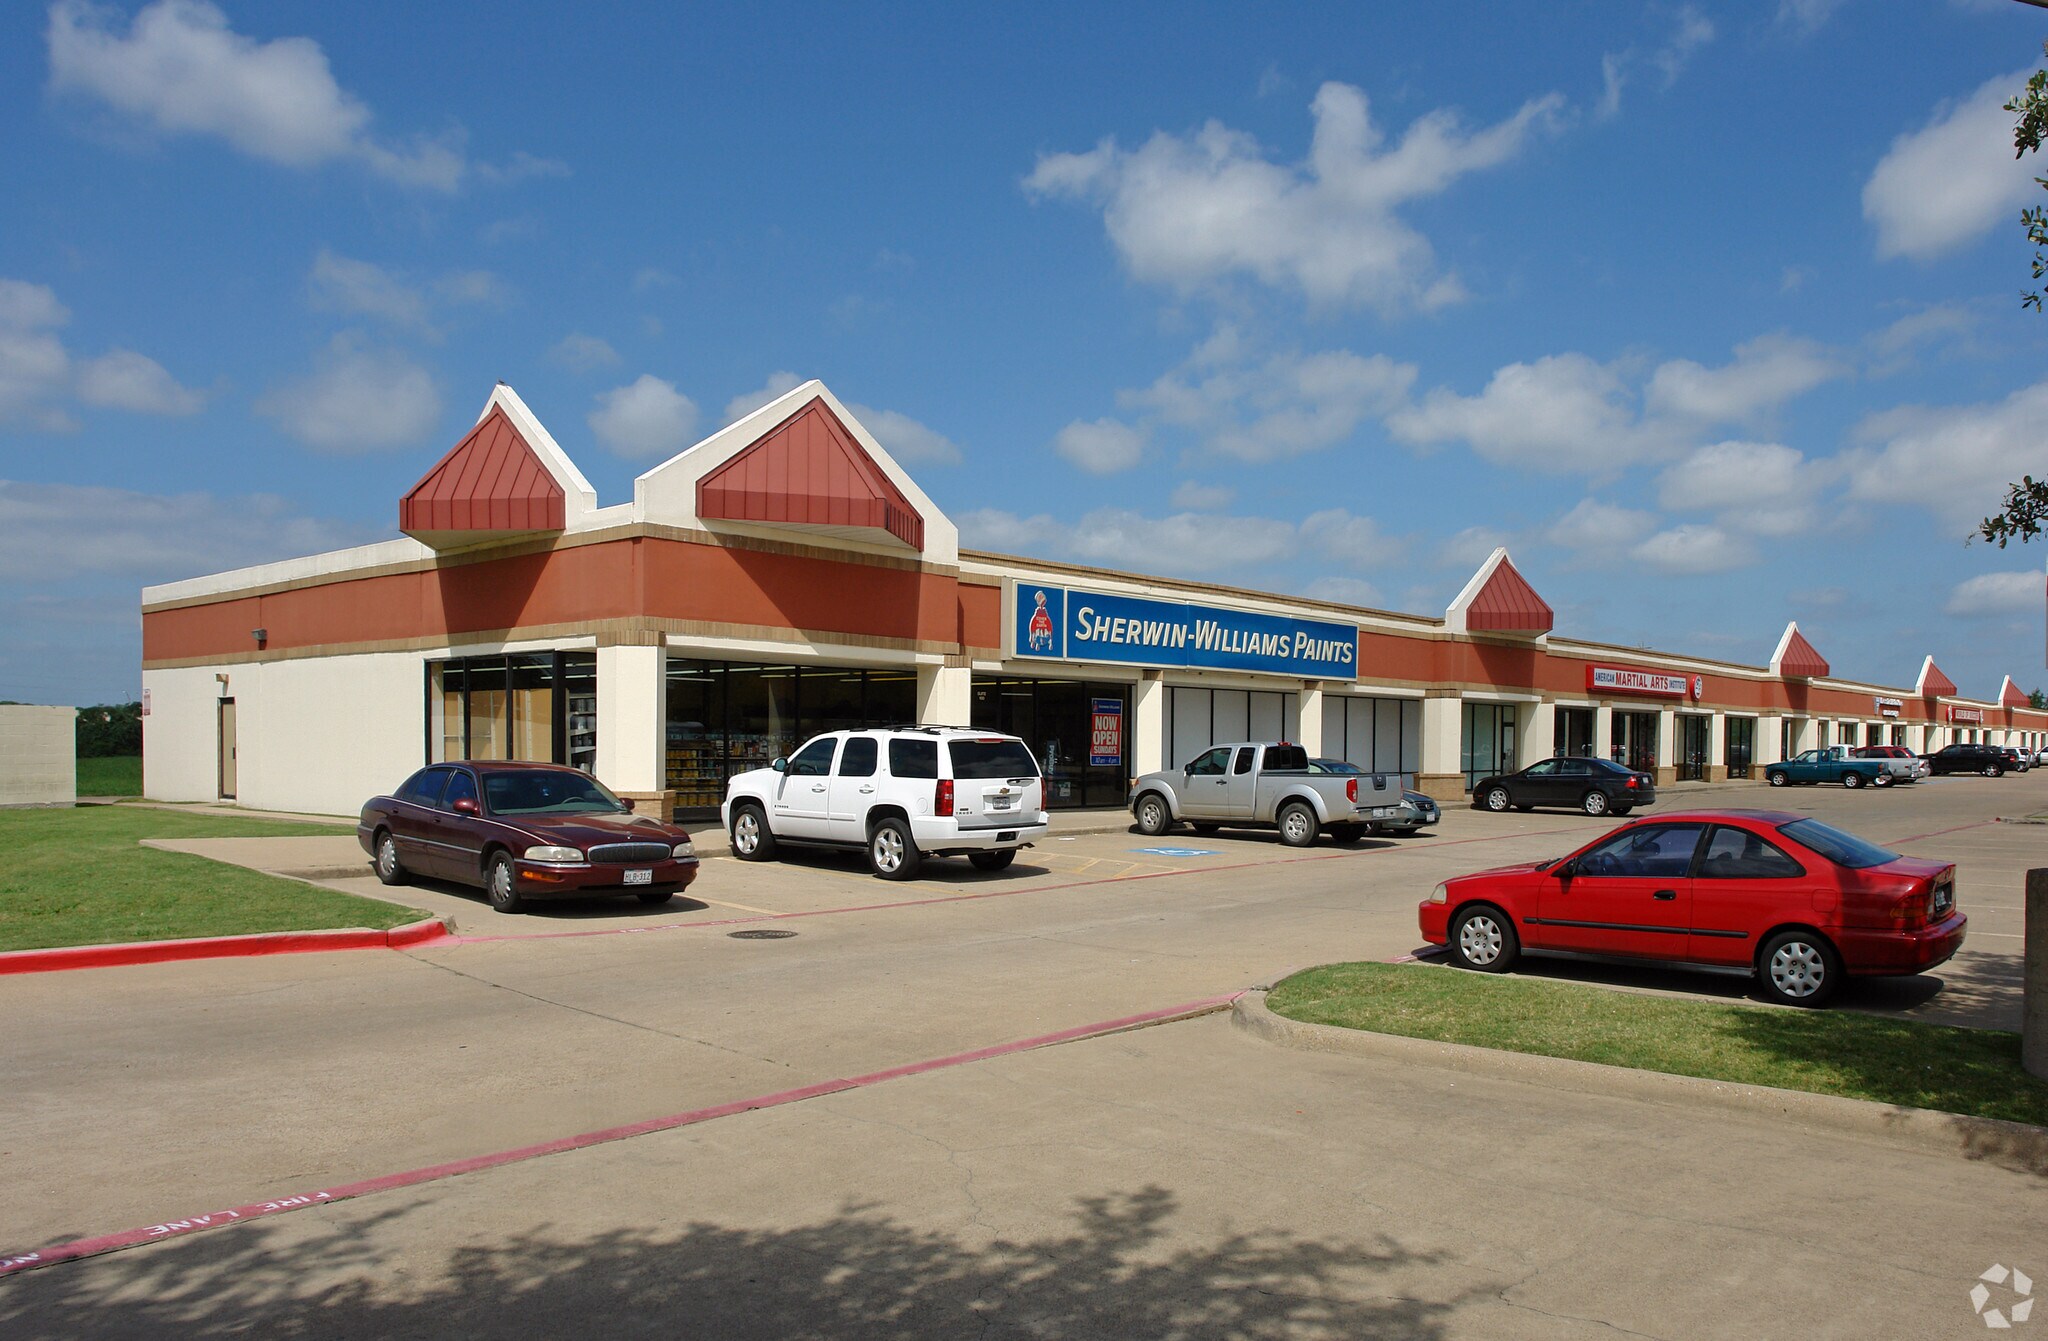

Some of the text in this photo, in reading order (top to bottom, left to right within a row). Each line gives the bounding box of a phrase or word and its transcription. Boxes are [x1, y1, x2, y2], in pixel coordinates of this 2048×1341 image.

[1075, 606, 1353, 664] SHERWIN-WILLIAMS PAINTS
[1595, 671, 1615, 683] AMERICAN
[1615, 671, 1648, 688] MARTIAL
[1650, 676, 1669, 690] ARTS
[1095, 716, 1118, 730] NOW
[1093, 731, 1118, 745] OPEN
[1094, 745, 1117, 754] SUNDAYS
[143, 1191, 331, 1236] FIRE LANE
